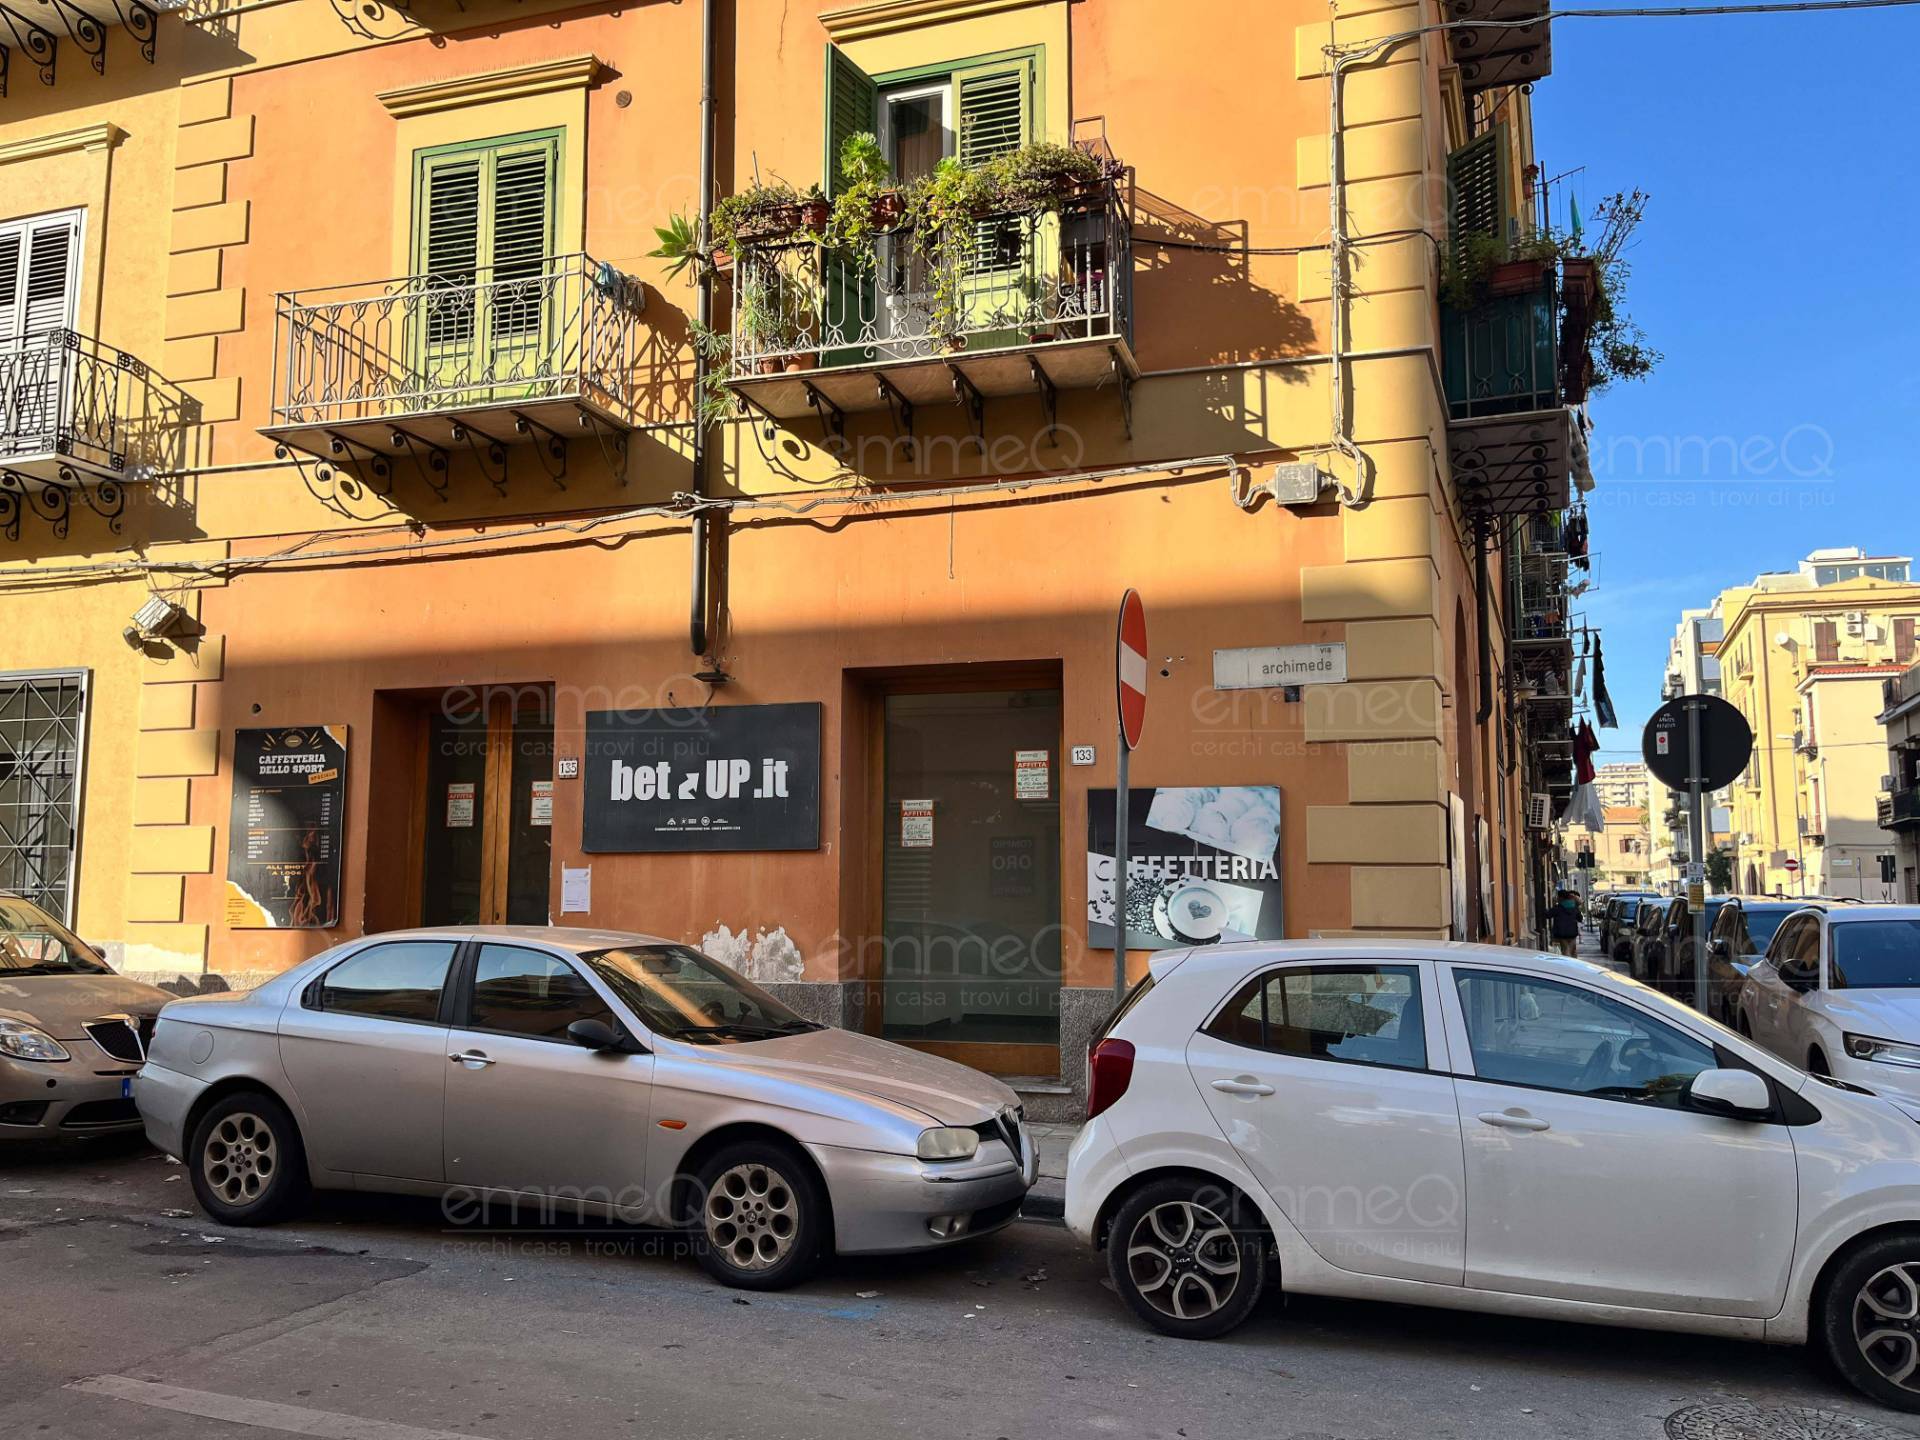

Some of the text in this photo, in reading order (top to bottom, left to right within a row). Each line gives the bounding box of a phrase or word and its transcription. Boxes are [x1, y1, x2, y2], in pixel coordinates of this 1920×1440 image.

[1262, 659, 1332, 674] archimede
[259, 754, 326, 765] CAFFETTERIA
[1074, 750, 1092, 761] 133
[259, 764, 325, 775] DELLO SPORT
[560, 762, 577, 774] 135
[610, 759, 671, 801] bet
[903, 810, 932, 818] AFFITTA
[1095, 855, 1279, 882] CFFETTERIA
